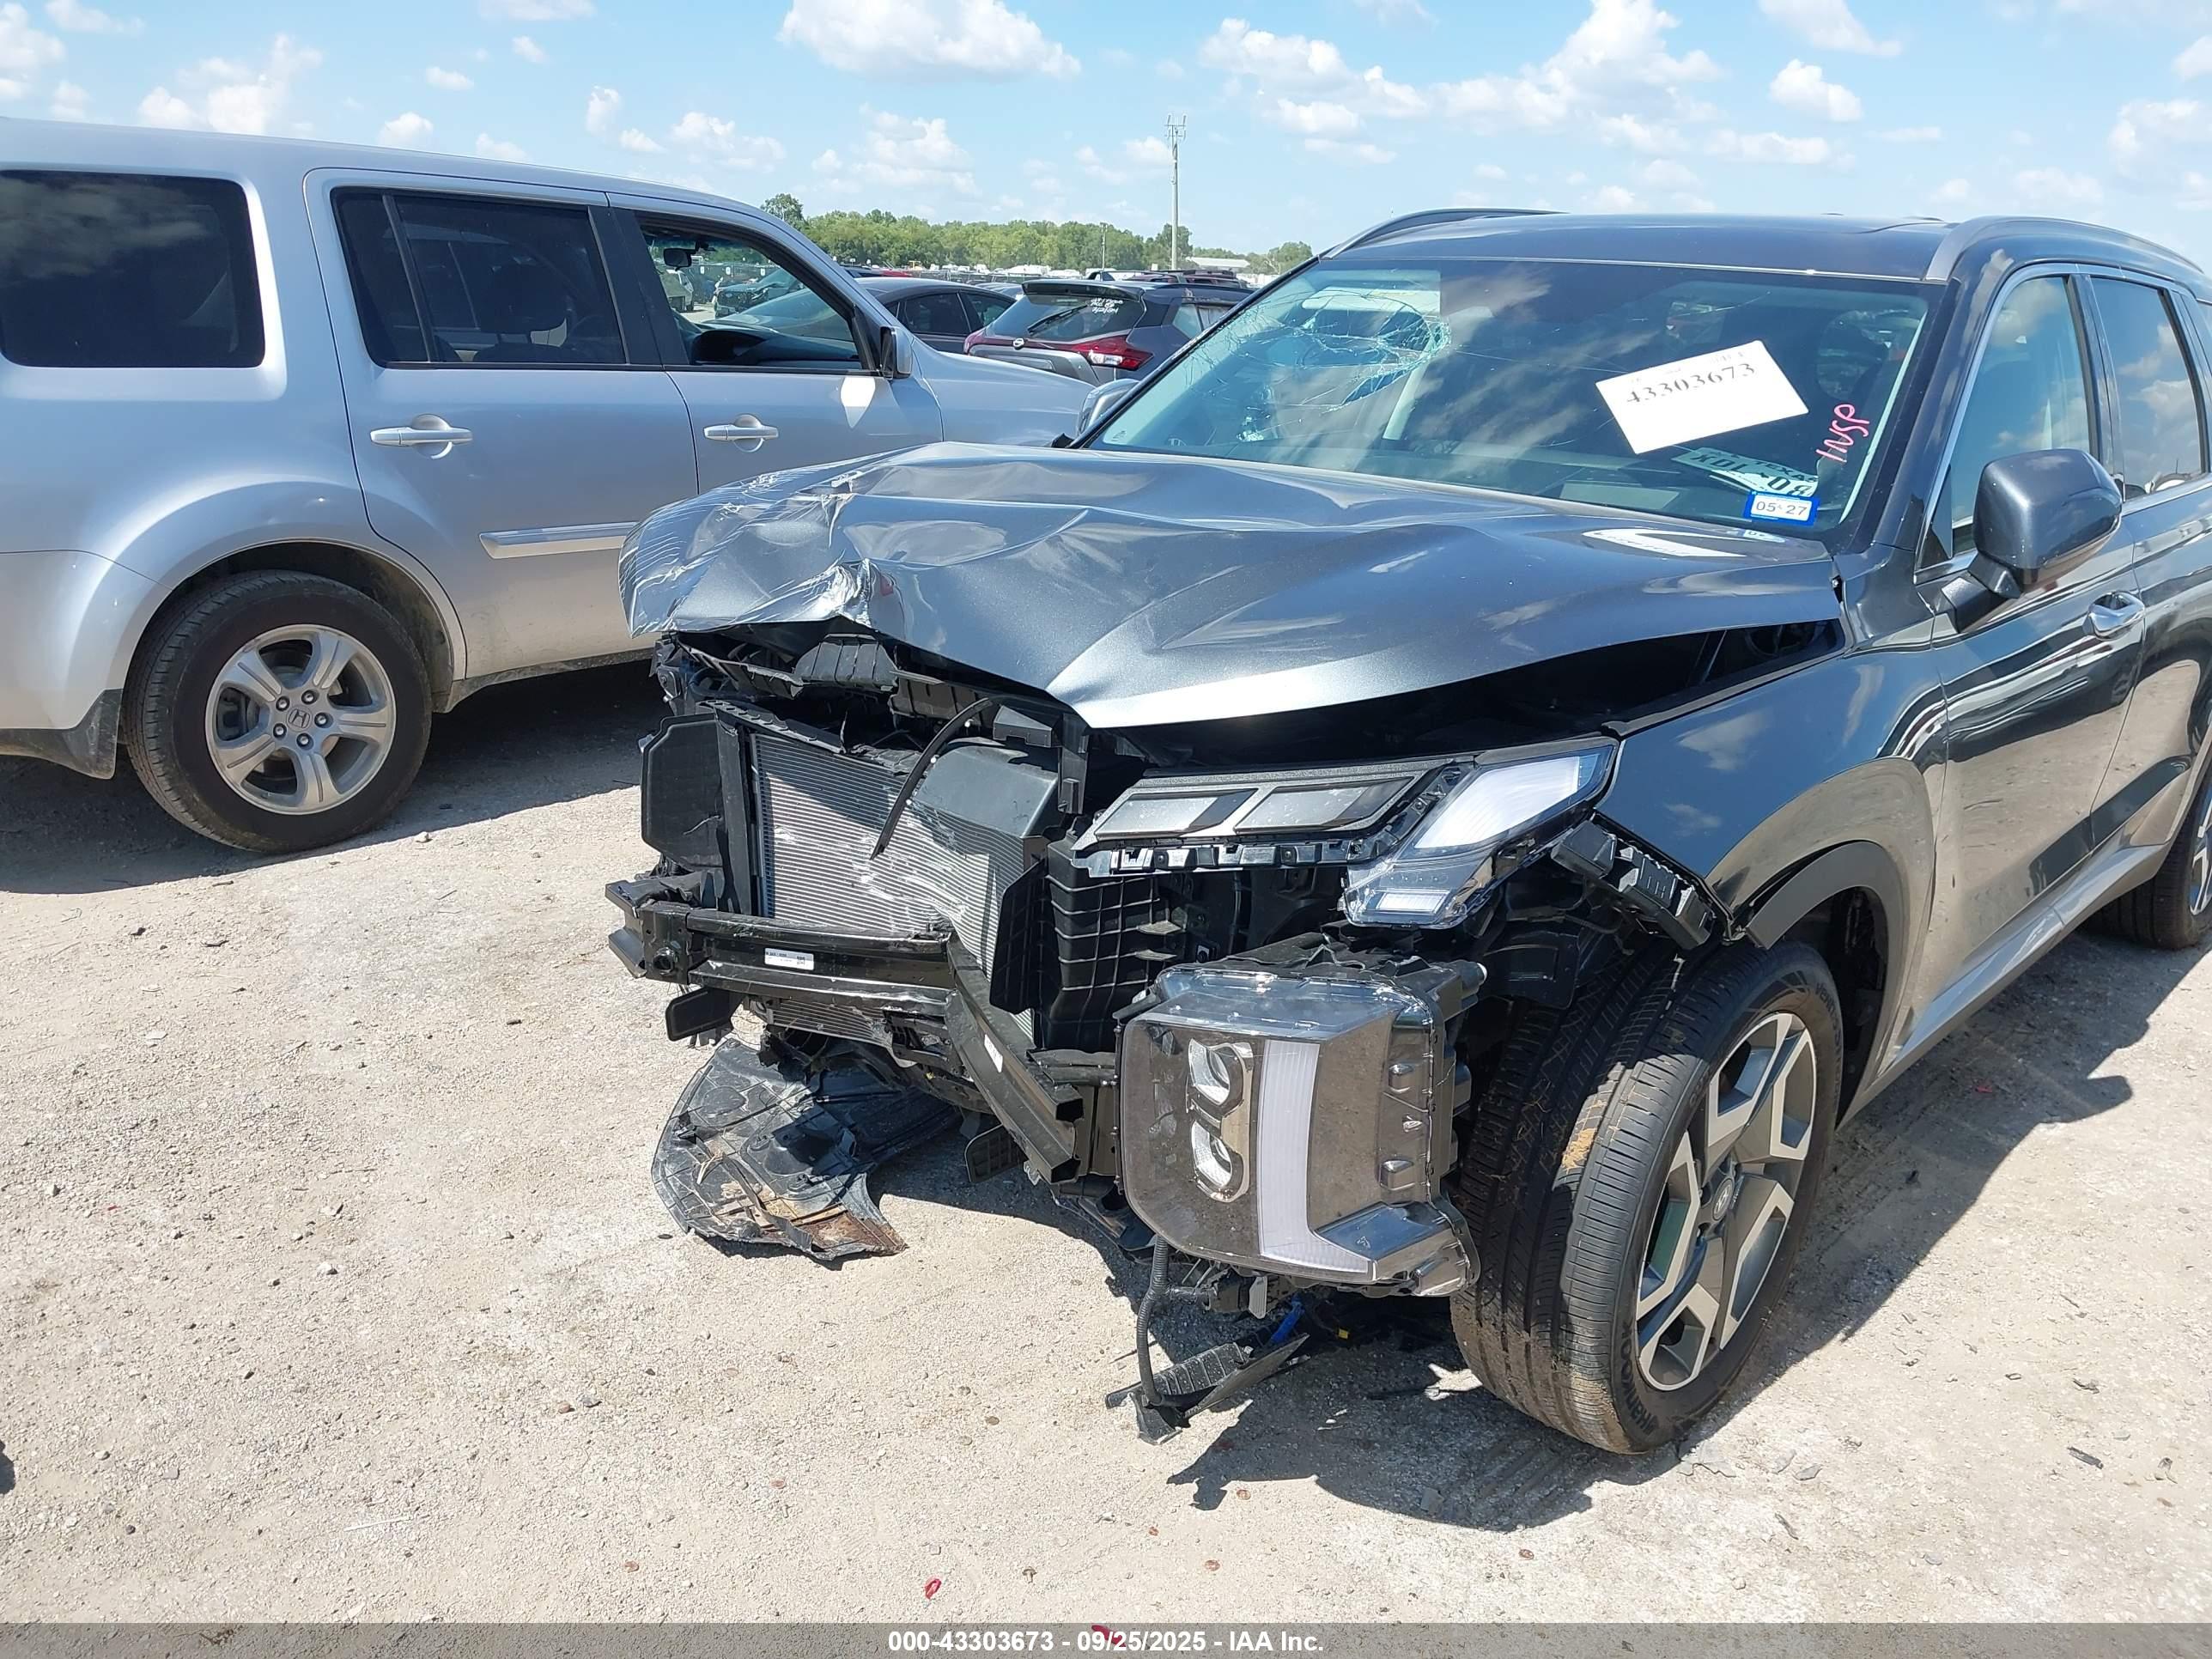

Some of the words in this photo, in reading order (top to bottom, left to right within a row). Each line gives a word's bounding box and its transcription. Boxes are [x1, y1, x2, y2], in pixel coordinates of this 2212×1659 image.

[1626, 362, 1755, 403] 43303673
[1815, 404, 1870, 463] INSP
[1754, 459, 1820, 483] TEXAS
[1756, 501, 1777, 513] 05
[1785, 505, 1808, 516] 27
